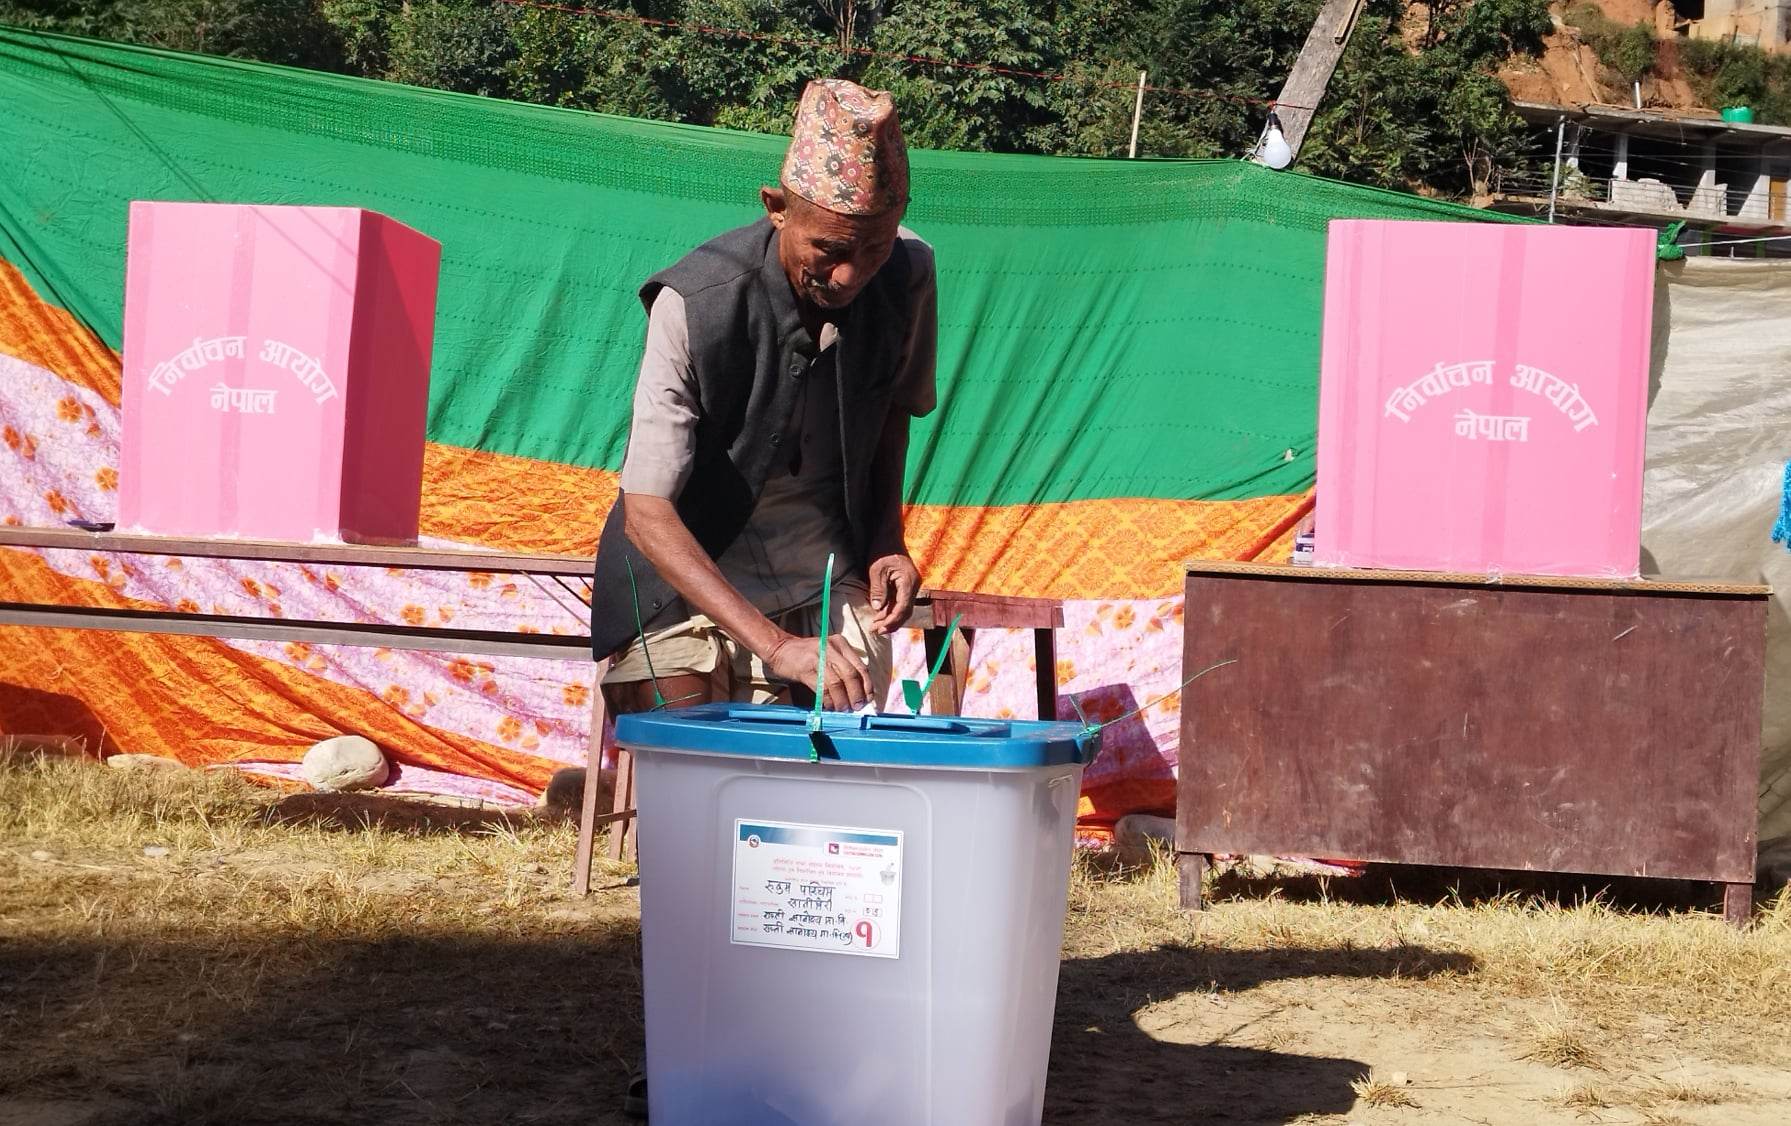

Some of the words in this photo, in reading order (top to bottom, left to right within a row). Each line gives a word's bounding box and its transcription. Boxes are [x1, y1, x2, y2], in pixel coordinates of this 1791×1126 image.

[147, 336, 247, 397] निर्वाचन
[258, 338, 339, 406] आयोग
[209, 381, 279, 414] नेपाल
[1383, 360, 1497, 424] निर्वाचन
[1509, 362, 1600, 433] आयोग
[1453, 408, 1533, 442] नेपाल
[855, 920, 873, 948] १
